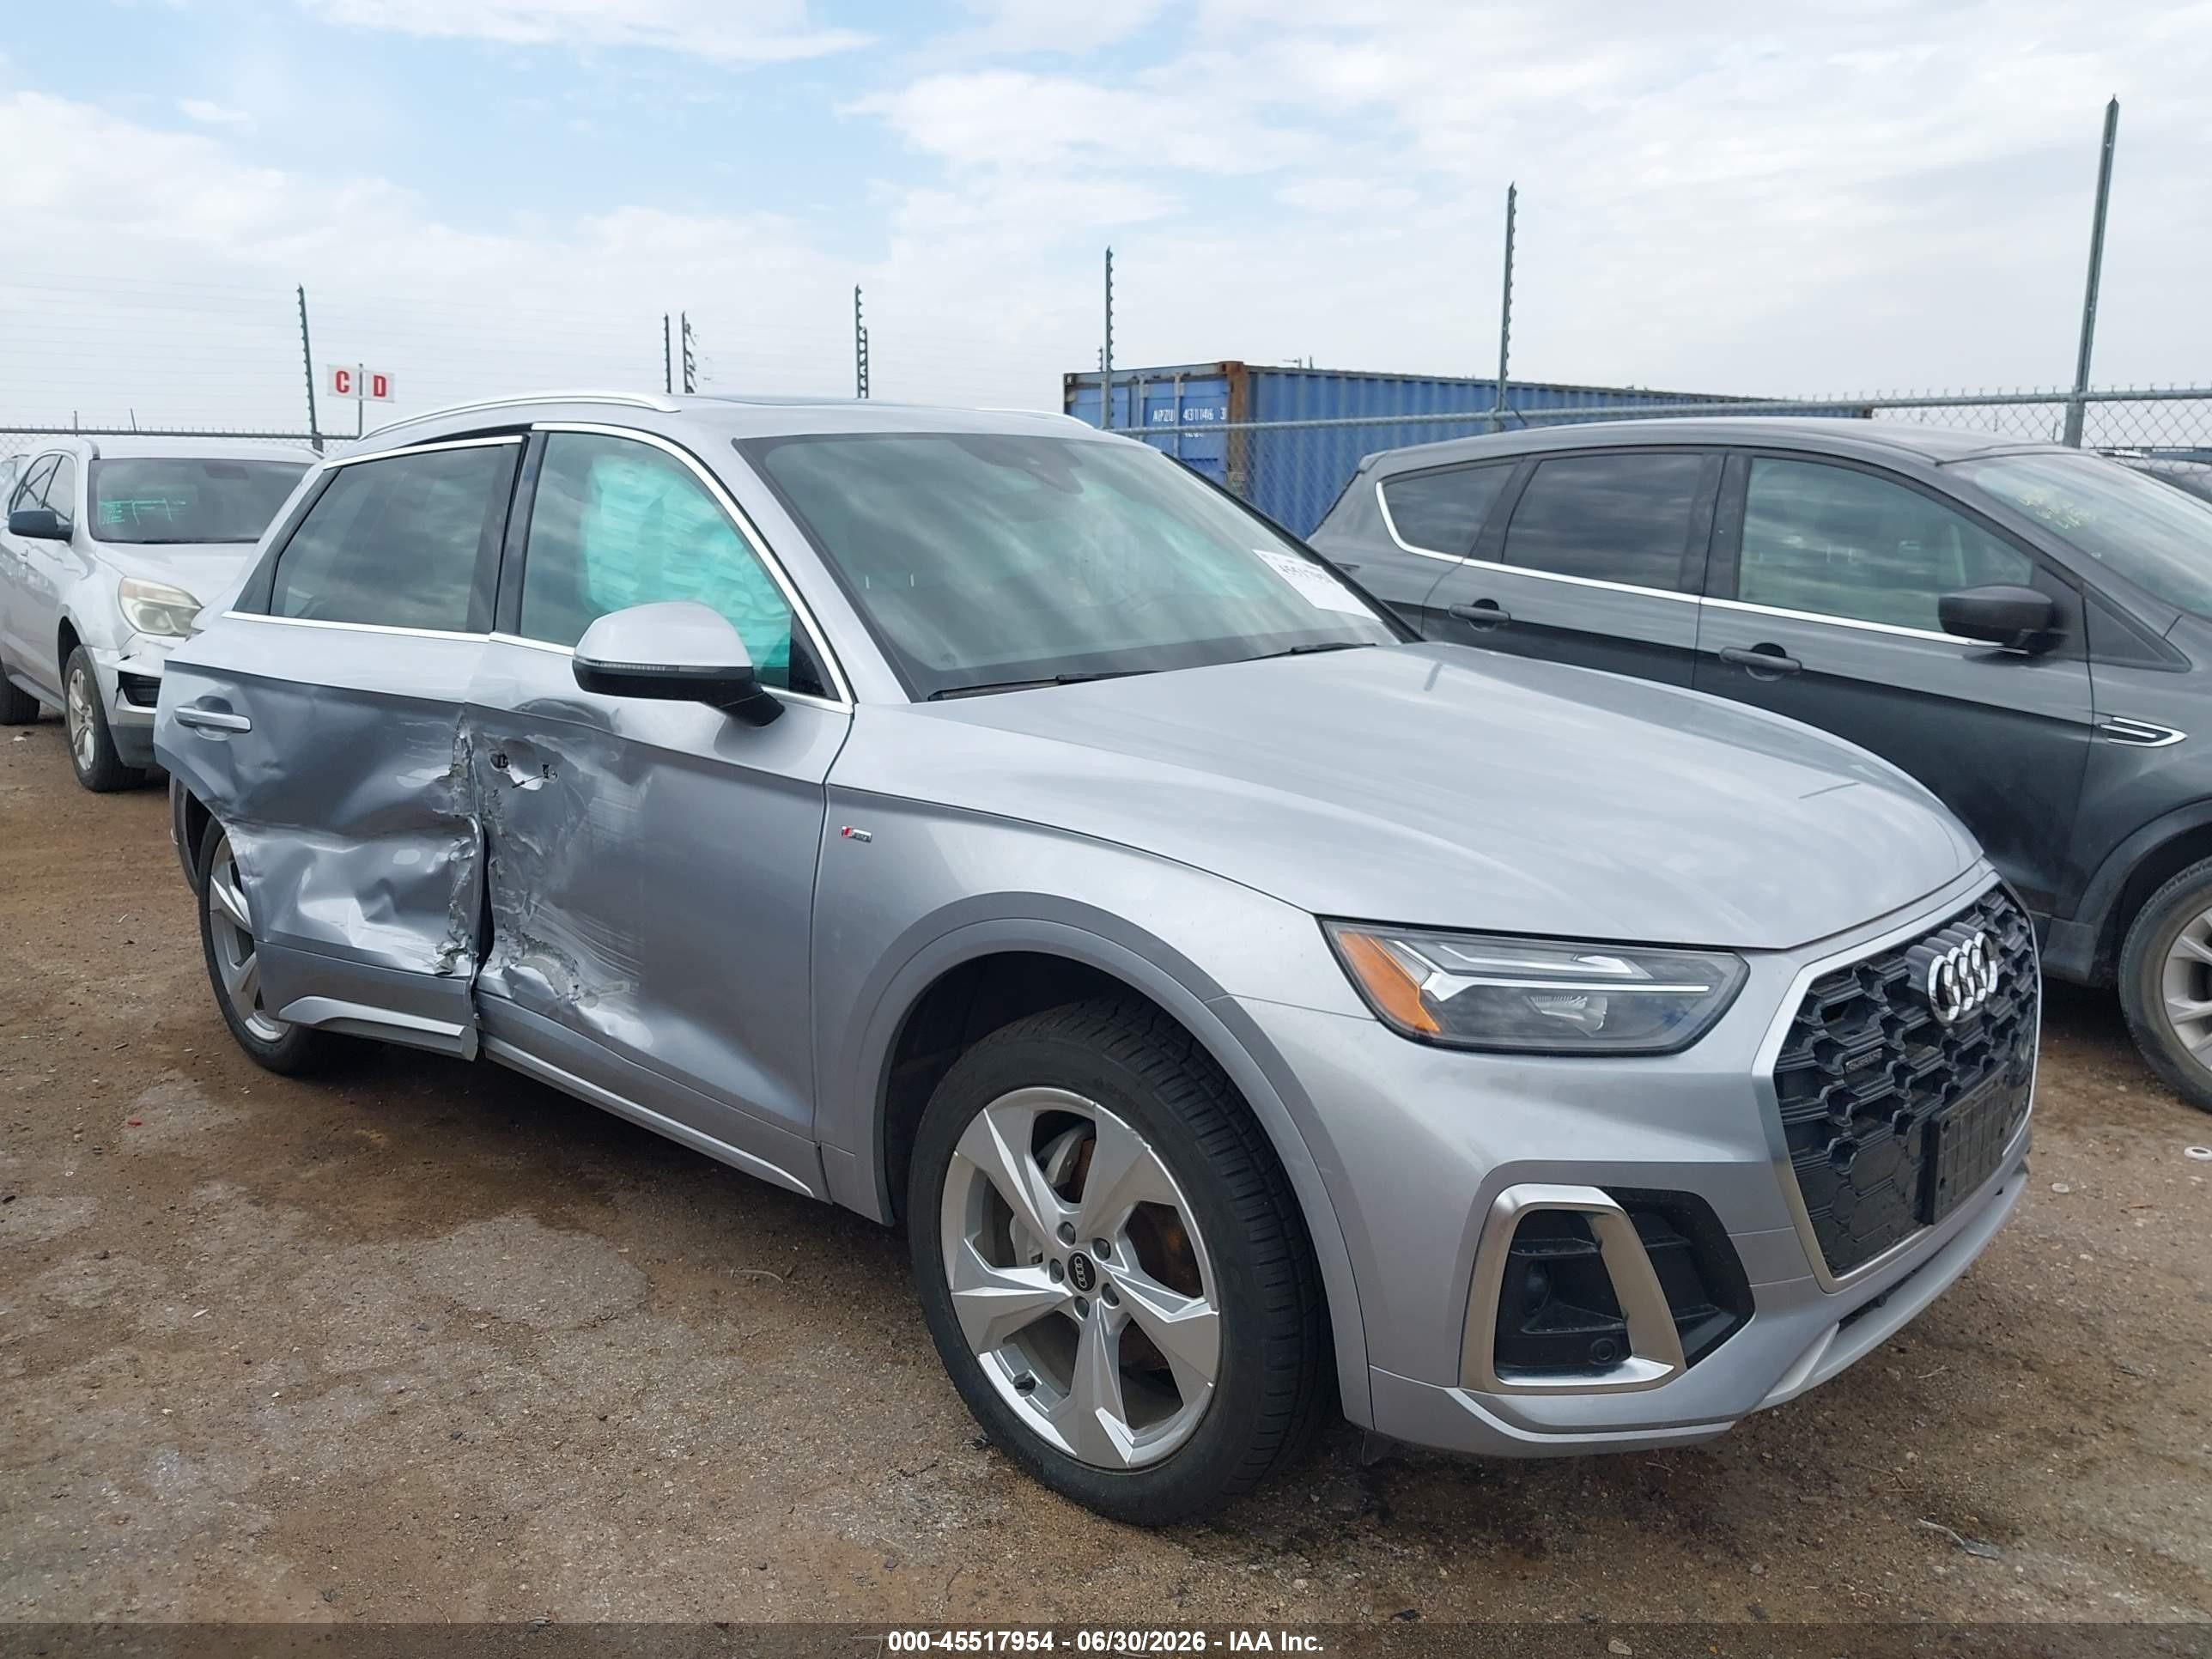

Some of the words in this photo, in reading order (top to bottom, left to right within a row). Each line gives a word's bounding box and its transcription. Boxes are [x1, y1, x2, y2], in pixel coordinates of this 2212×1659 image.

[336, 370, 349, 393] C
[374, 374, 386, 398] D
[1220, 407, 1228, 420] 3
